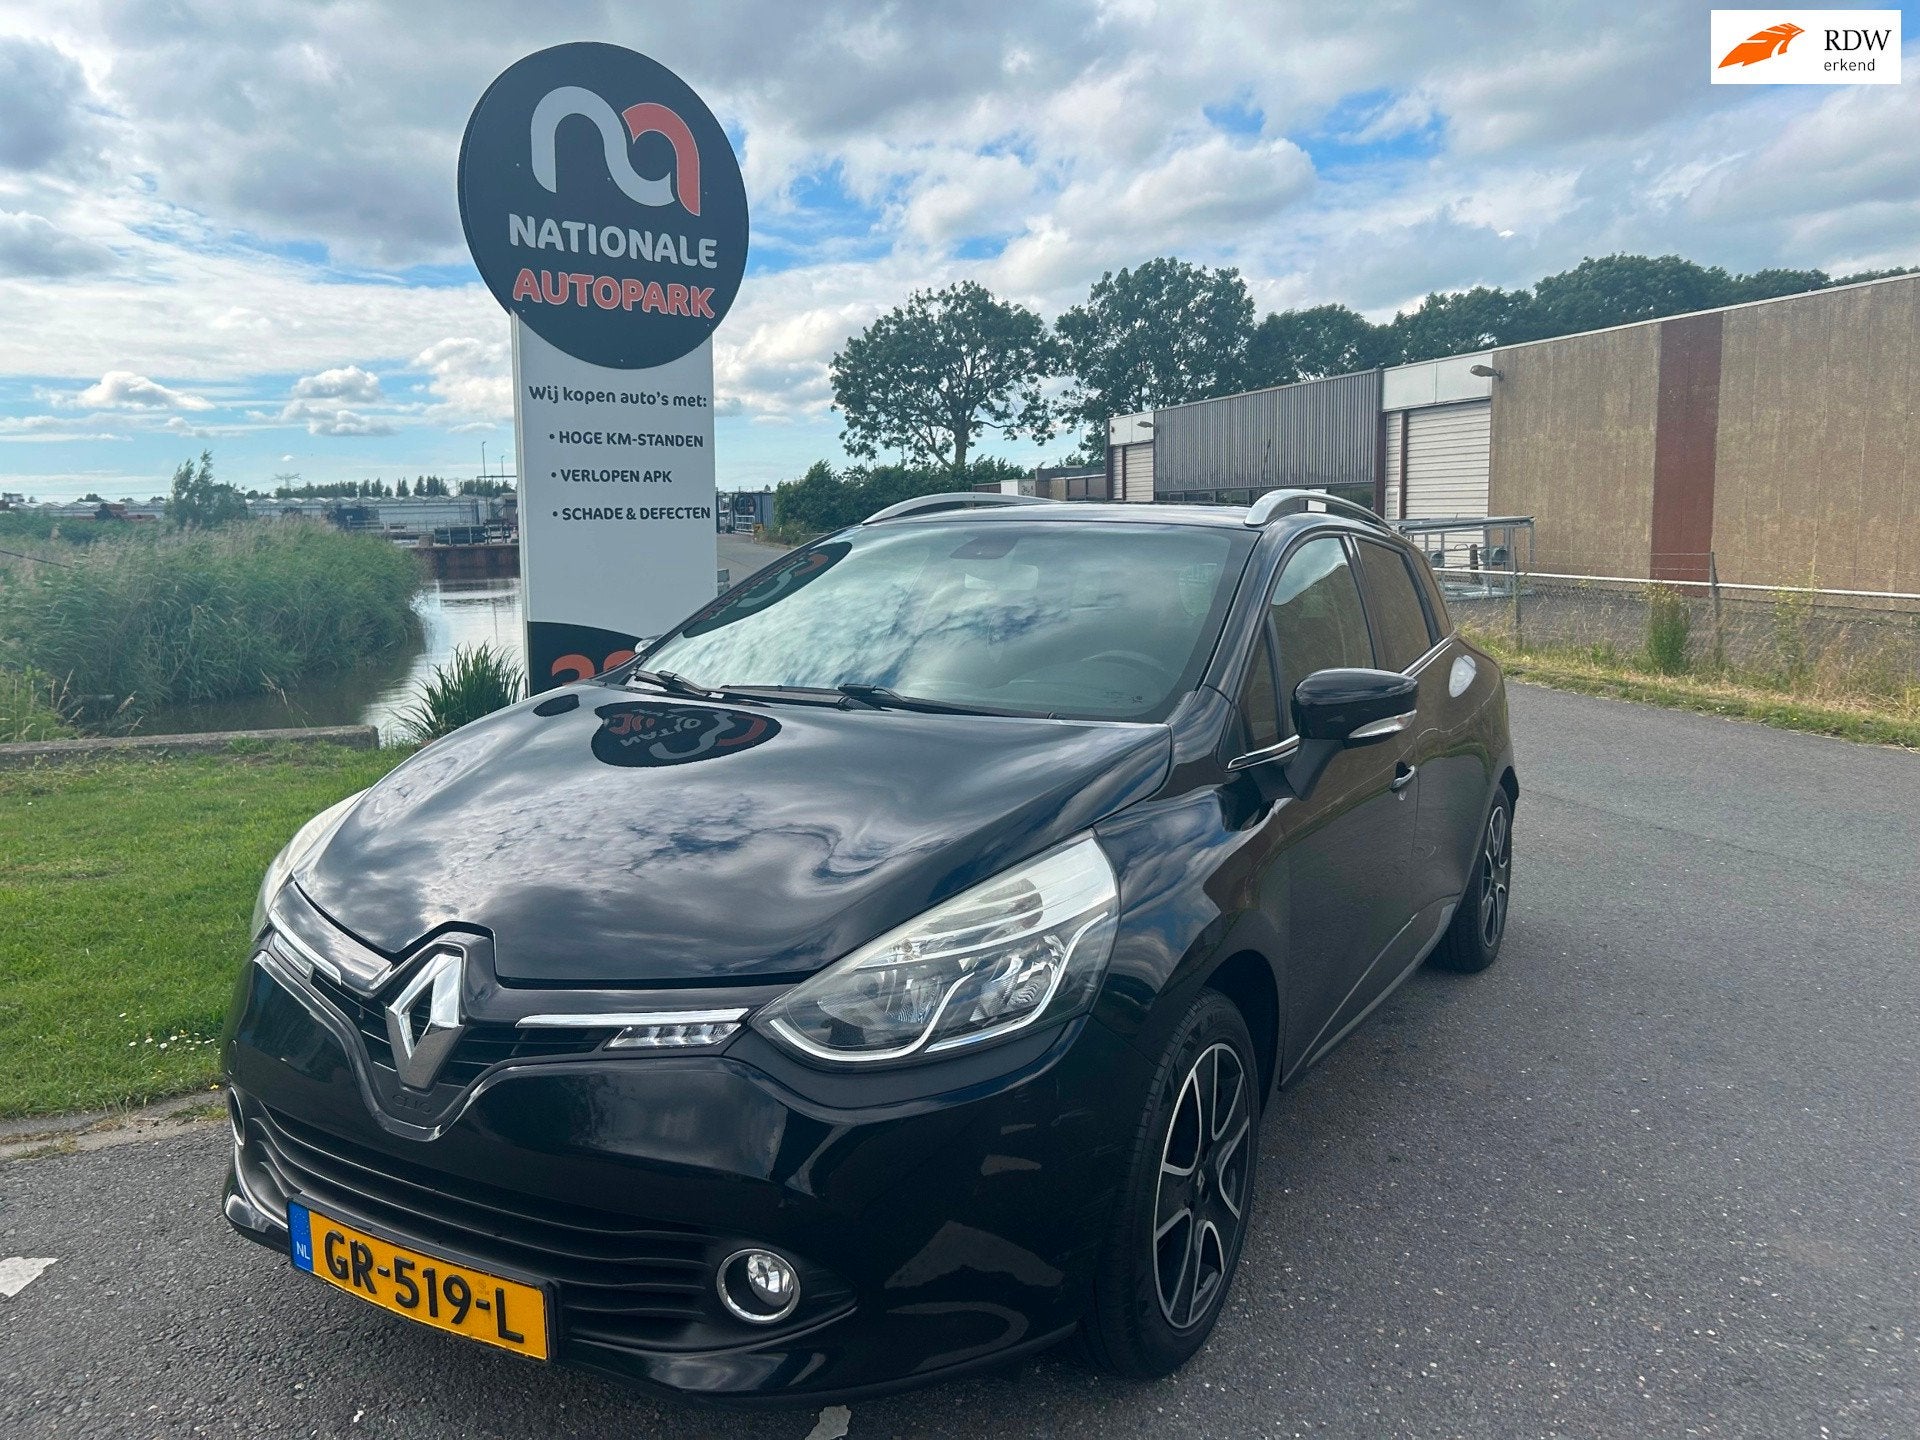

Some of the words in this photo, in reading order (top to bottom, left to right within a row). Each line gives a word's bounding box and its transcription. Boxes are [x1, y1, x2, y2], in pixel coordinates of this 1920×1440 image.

[508, 213, 718, 269] NATIONALE
[512, 268, 715, 319] AUTOPARK
[528, 385, 559, 404] Wij
[563, 386, 616, 404] kopen
[620, 391, 669, 406] auto's
[673, 394, 707, 408] met:
[559, 431, 603, 445] HOGE
[606, 432, 704, 448] KM-STANDEN
[560, 469, 640, 483] VERLOPEN
[643, 470, 673, 483] APK
[562, 507, 624, 521] SCHADE
[626, 508, 637, 520] &
[640, 507, 711, 520] DEFECTEN
[296, 1241, 311, 1260] NL
[324, 1230, 525, 1344] GR-519-L
